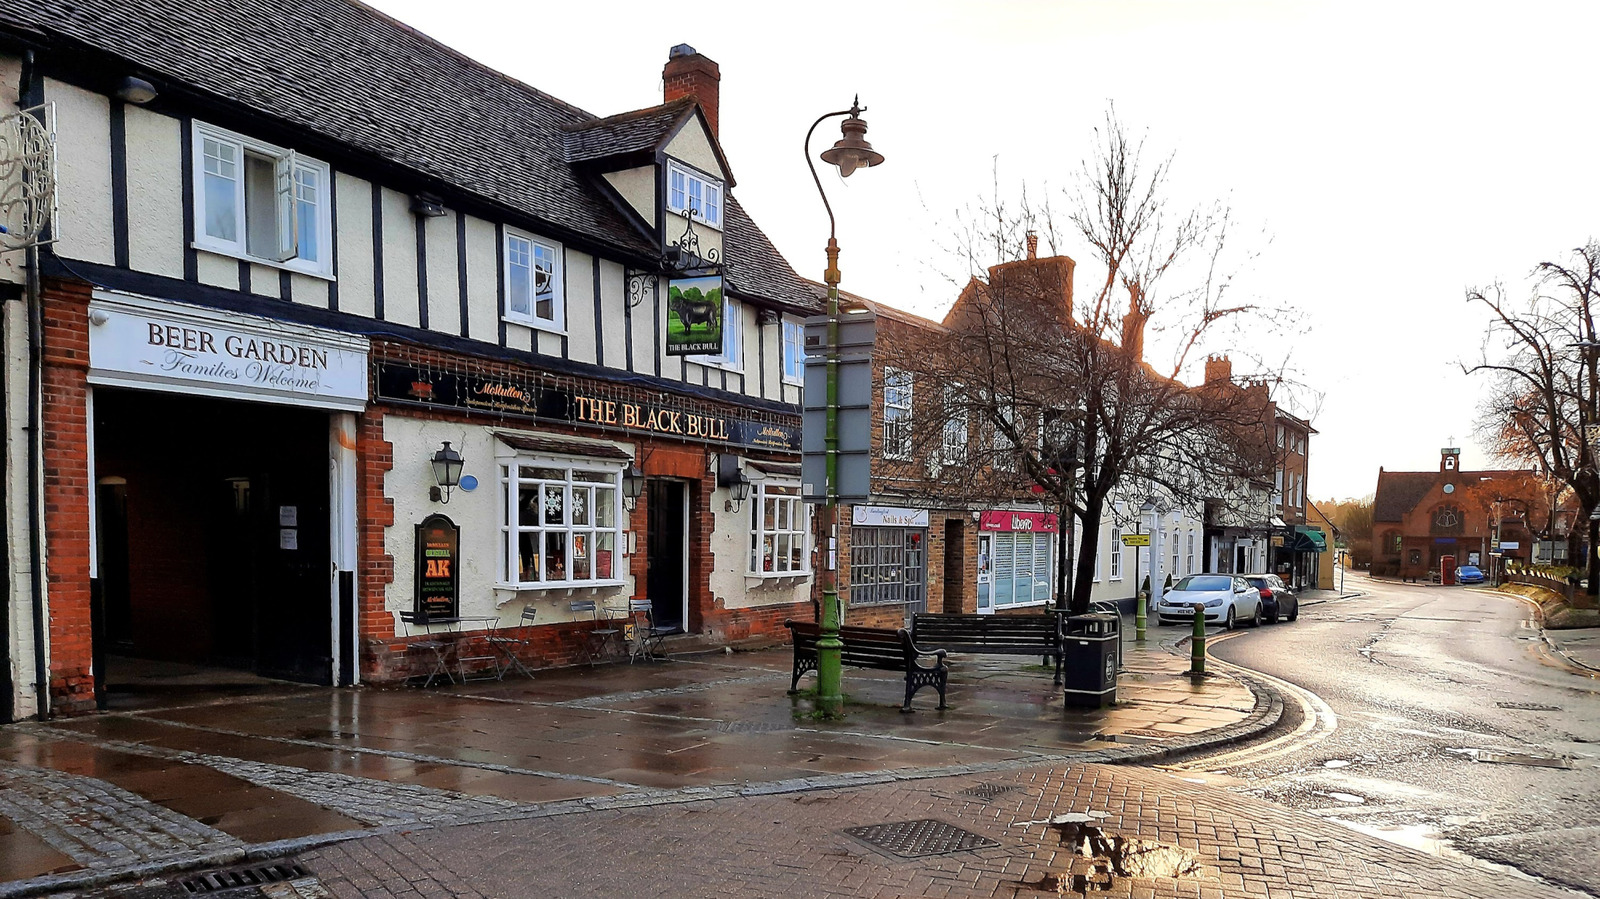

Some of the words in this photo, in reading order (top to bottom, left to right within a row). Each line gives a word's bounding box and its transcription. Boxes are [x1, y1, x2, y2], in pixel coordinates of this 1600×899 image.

[147, 322, 218, 354] BEER
[225, 335, 328, 370] GARDEN
[669, 343, 681, 351] THE
[681, 343, 701, 351] BLACK
[702, 342, 719, 350] BULL
[160, 349, 239, 380] Families
[245, 361, 318, 390] Welcome
[575, 396, 617, 424] THE
[622, 403, 682, 434] BLACK
[687, 414, 729, 440] BULL
[425, 559, 451, 578] AK
